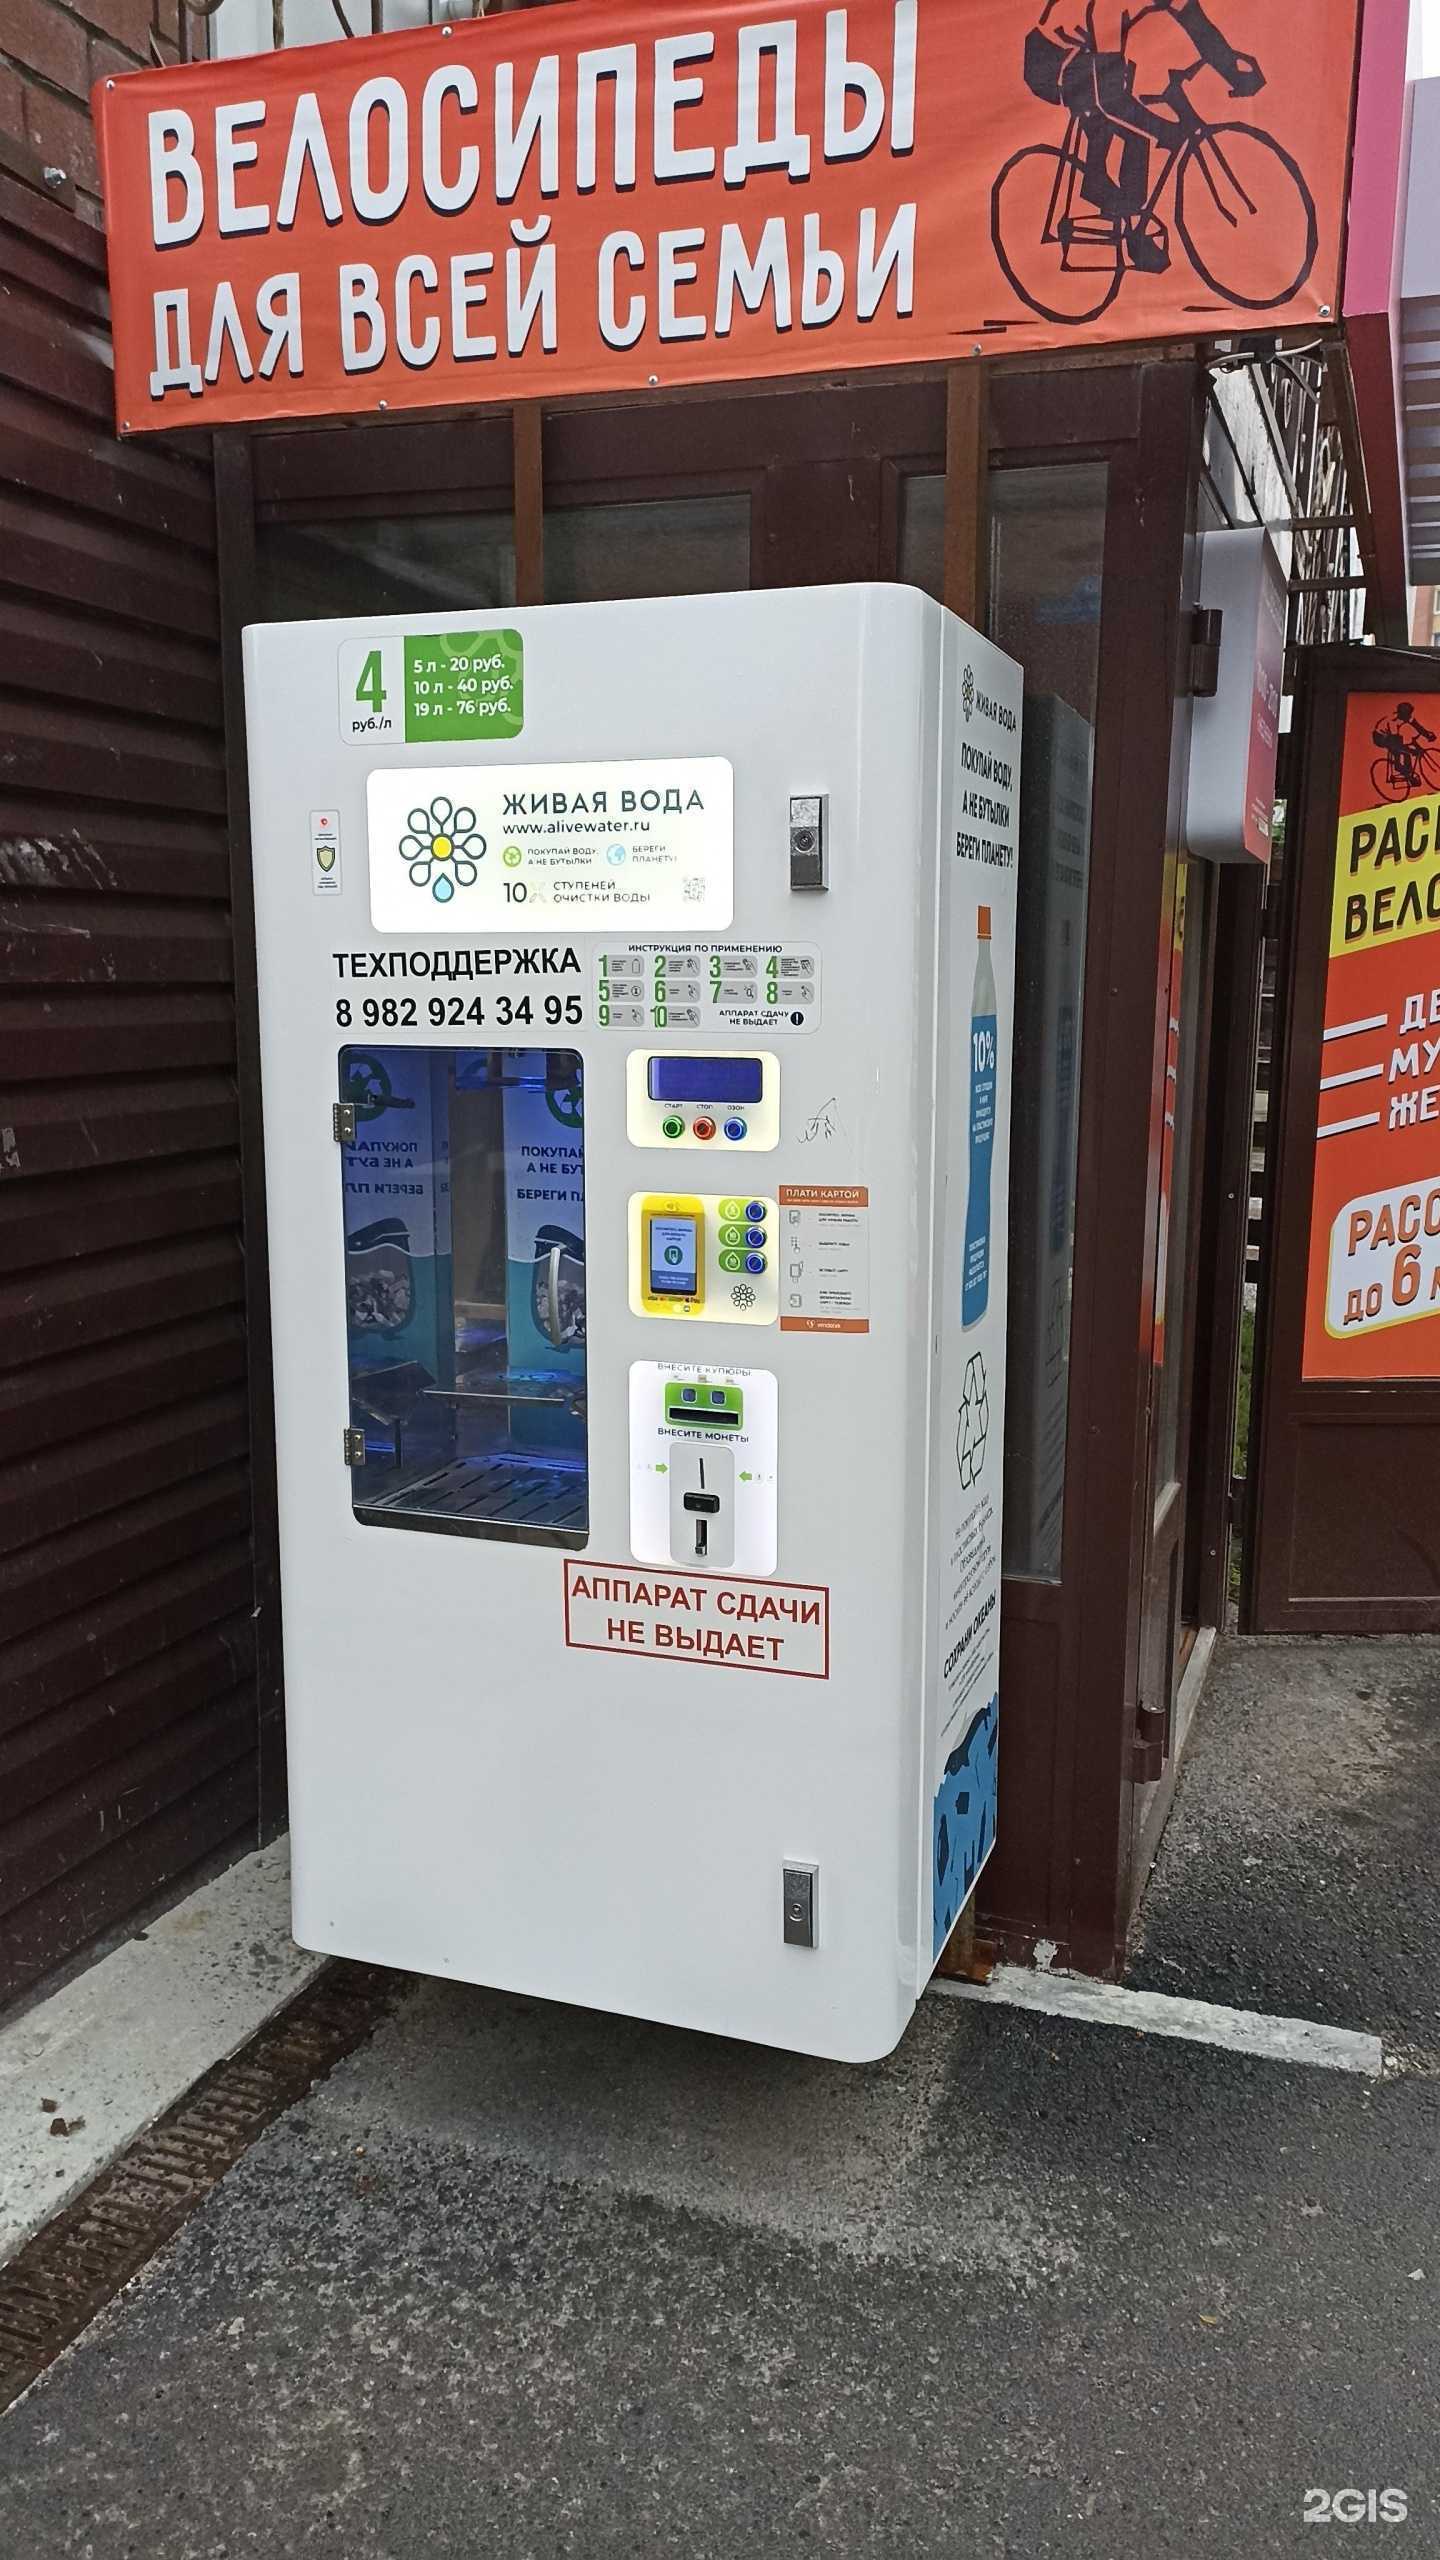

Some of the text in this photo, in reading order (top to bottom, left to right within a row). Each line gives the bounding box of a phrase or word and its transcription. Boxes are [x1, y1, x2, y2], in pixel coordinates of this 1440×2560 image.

[147, 0, 917, 247] ВЕЛОСИПЕДЫ
[150, 203, 918, 397] ДЛЯ ВСЕЙ СЕМЬИ
[414, 660, 422, 672] 5
[426, 661, 436, 672] л
[450, 657, 468, 672] 20
[473, 654, 505, 672] руб.
[356, 650, 387, 712] 4
[414, 681, 430, 694] 10
[434, 684, 444, 694] л
[457, 678, 478, 692] 40
[482, 675, 514, 694] руб.
[414, 703, 430, 716] 19
[433, 706, 443, 715] л
[456, 700, 476, 714] 76
[480, 698, 512, 716] руб.
[975, 689, 1017, 732] ЖИВАЯ ВОДА
[352, 716, 392, 732] руб./л
[961, 742, 992, 781] ПОКУПАЙ
[503, 788, 705, 815] ЖИВАЯ ВОДА
[962, 789, 1010, 828] А НЕ БУТЫЛКИ
[503, 819, 650, 834] www.alivewater.ru
[527, 847, 571, 856] ПОКУПАЙ
[632, 845, 666, 854] БЕРЕГИ
[956, 831, 1014, 869] БЕРЕГИ ПЛАНЕТУ!
[536, 858, 547, 866] НЕ
[550, 858, 592, 866] БУТЫЛКИ
[503, 882, 528, 903] 10
[554, 880, 616, 890] СТУПЕНЕЙ
[554, 893, 650, 904] ОЧИСТКИ ВОДЫ
[628, 944, 782, 953] ИНСТРУКЦИЯ ПО ПРИМЕНЕНИЮ
[332, 948, 582, 980] ТЕХПОДДЕРЖКА
[598, 954, 608, 977] 1
[654, 955, 666, 978] 2
[710, 956, 721, 978] 3
[766, 956, 779, 978] 4
[598, 980, 610, 1002] 5
[654, 980, 666, 1003] 6
[709, 981, 722, 1004] 7
[766, 982, 778, 1004] 8
[336, 994, 583, 1027] 8 982 924 34 95
[598, 1004, 610, 1026] 9
[650, 1005, 668, 1028] 10
[760, 1010, 789, 1018] СДАЧУ
[743, 1018, 778, 1026] ВЫДАЕТ
[973, 1030, 995, 1073] 10%
[1388, 1085, 1440, 1131] ЖЕ
[526, 1162, 536, 1173] А
[540, 1162, 557, 1174] НЕ
[517, 1188, 567, 1201] БЕРЕГИ
[786, 1188, 818, 1198] ПЛАТИ
[1344, 1283, 1383, 1325] ДО
[1392, 1244, 1422, 1306] 6
[658, 1362, 751, 1376] ВНЕСИТЕ КУПЮРЫ
[658, 1428, 748, 1442] ВНЕСИТЕ МОНЕТЫ
[572, 1576, 820, 1626] АППАРАТ СДАЧИ
[607, 1618, 784, 1661] НЕ ВЫДАЕТ
